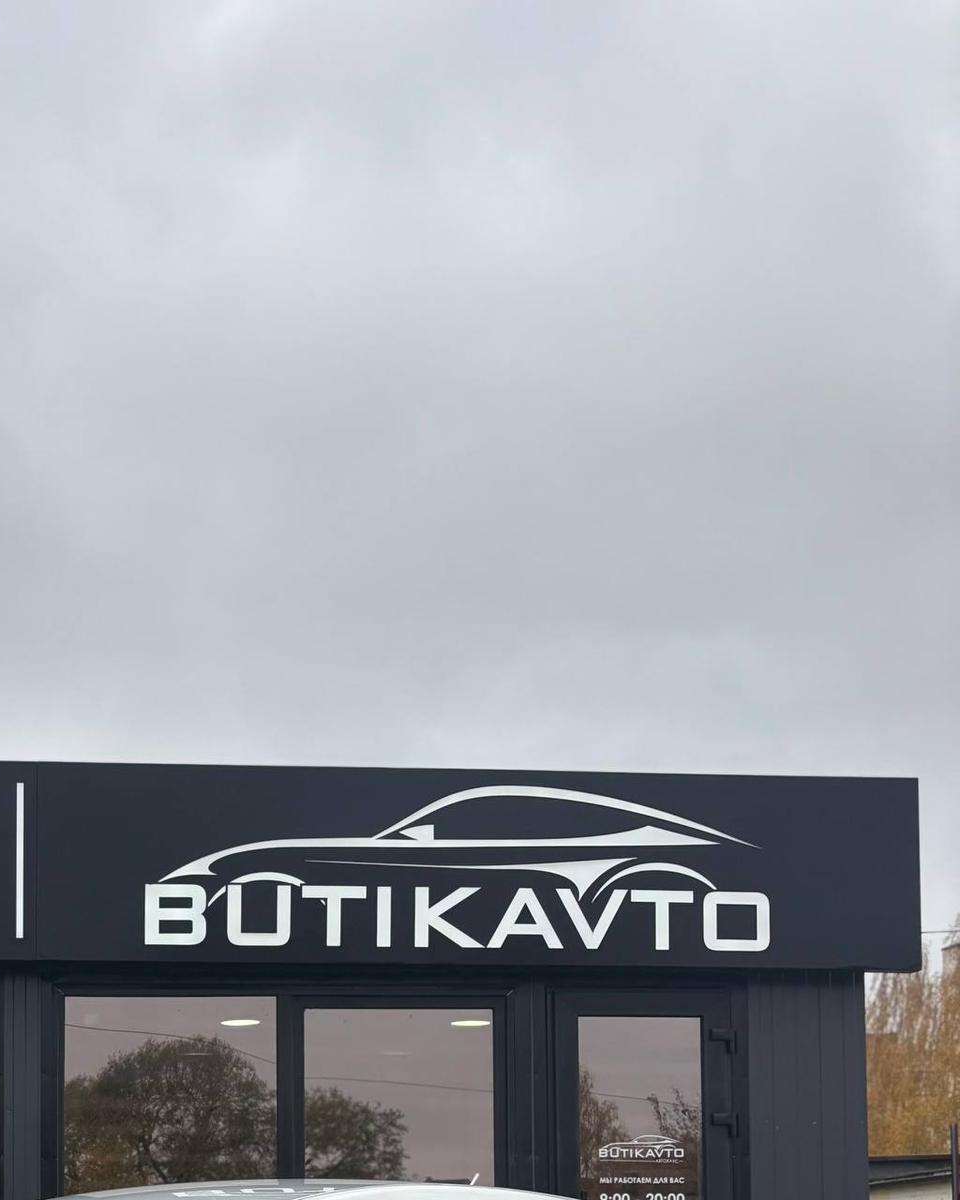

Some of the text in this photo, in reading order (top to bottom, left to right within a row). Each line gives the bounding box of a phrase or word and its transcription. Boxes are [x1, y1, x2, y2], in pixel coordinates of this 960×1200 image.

[144, 883, 772, 952] BUTIKAVTO
[598, 1148, 685, 1158] BUTIKAVTO
[653, 1177, 668, 1185] ДЛЯ
